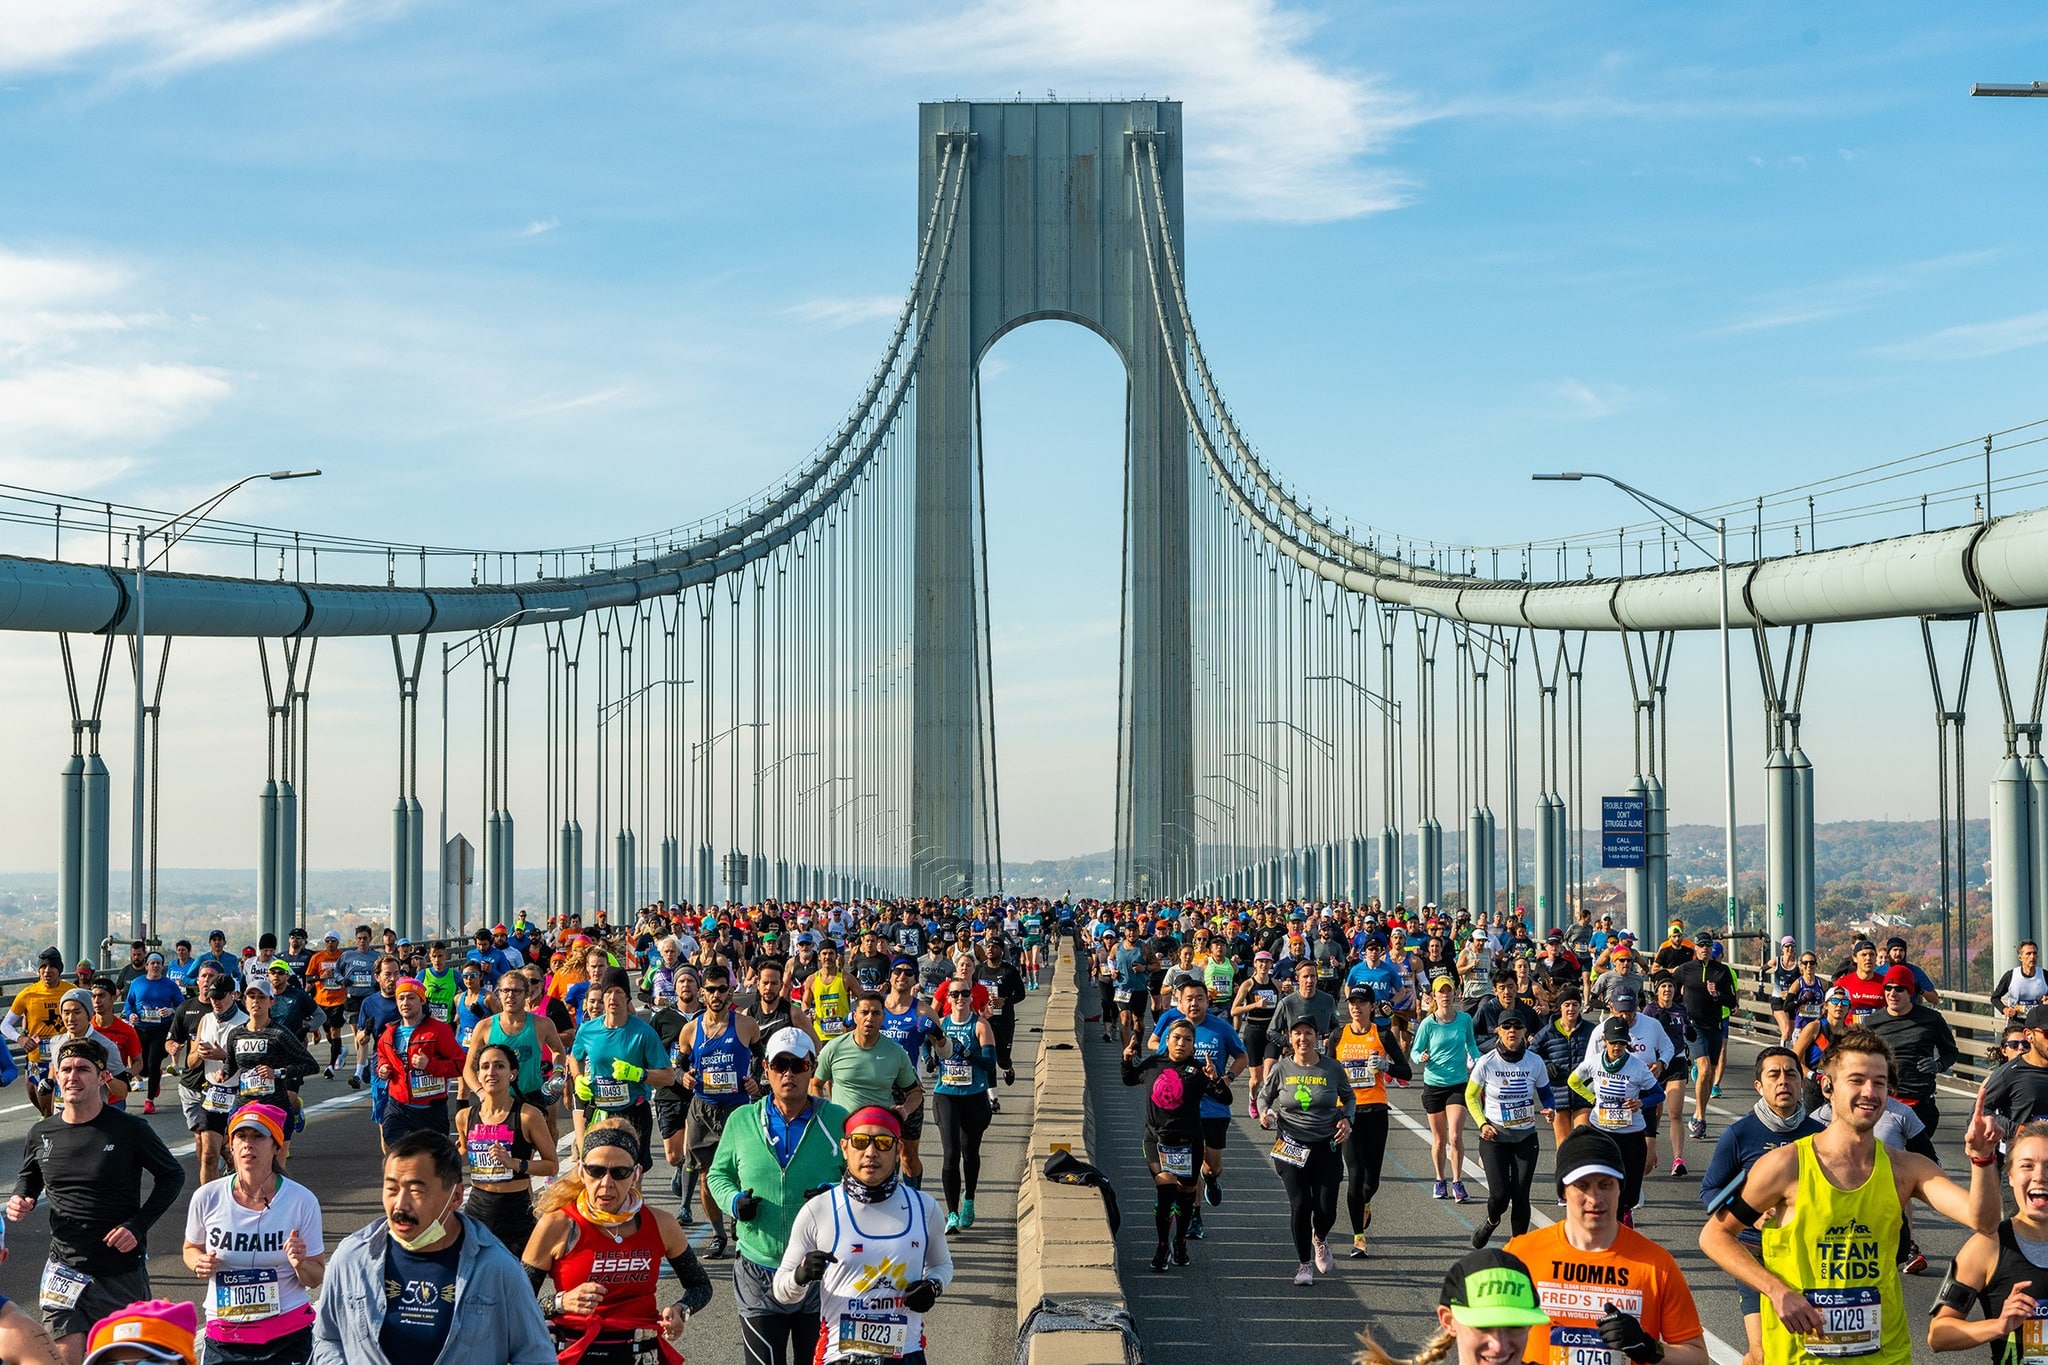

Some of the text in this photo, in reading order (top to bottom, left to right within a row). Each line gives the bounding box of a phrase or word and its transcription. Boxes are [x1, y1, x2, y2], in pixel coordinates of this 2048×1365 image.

[1604, 801, 1623, 809] TROUBLE
[896, 1030, 910, 1039] CITY
[243, 1039, 266, 1051] OVO
[701, 1053, 734, 1066] JERSEY CITY
[713, 1073, 728, 1083] 9640
[1352, 1067, 1366, 1077] 9721
[1597, 1071, 1631, 1081] URUGUAY
[602, 1086, 621, 1096] 10493
[210, 1227, 284, 1252] SARAH!
[1817, 1242, 1878, 1260] TEAM
[592, 1258, 653, 1273] ESSEX
[1829, 1262, 1880, 1280] KIDS
[223, 1275, 239, 1285] tcs
[588, 1273, 650, 1284] RACING
[1551, 1260, 1629, 1287] TUOMAS
[1537, 1281, 1562, 1289] MEMORIAL
[234, 1285, 266, 1305] 10576
[1542, 1292, 1638, 1311] FRED'S TEAM
[1813, 1293, 1833, 1304] tcs
[1829, 1308, 1865, 1332] 12129
[862, 1323, 892, 1344] 8223
[1562, 1331, 1582, 1344] tcs
[1576, 1350, 1612, 1365] 9759
